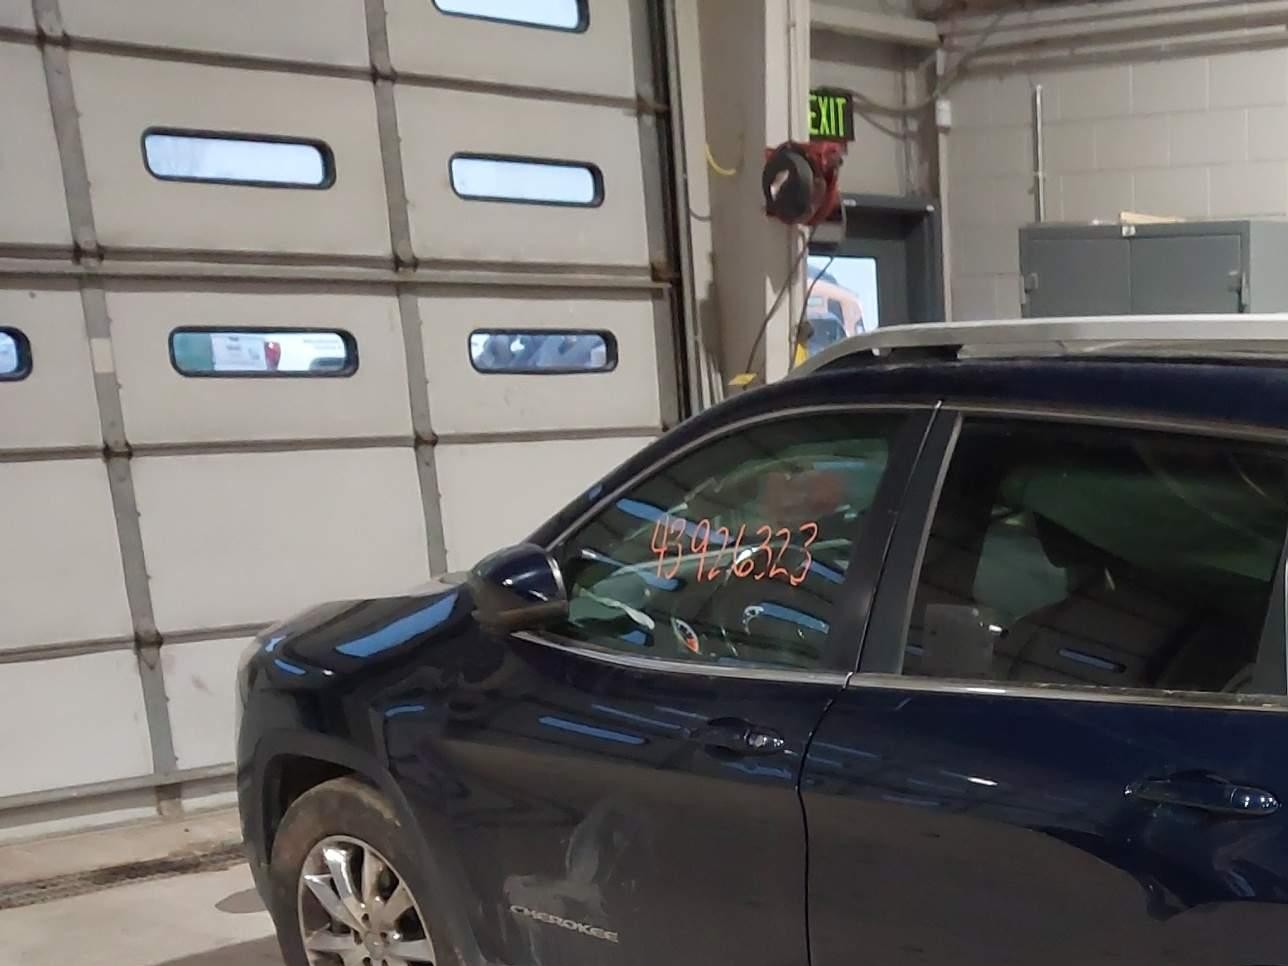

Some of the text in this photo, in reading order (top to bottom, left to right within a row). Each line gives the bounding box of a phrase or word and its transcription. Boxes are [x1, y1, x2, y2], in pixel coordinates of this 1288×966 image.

[808, 95, 847, 137] EXIT
[652, 517, 818, 587] 43926323
[509, 904, 619, 944] CHEROKEE
